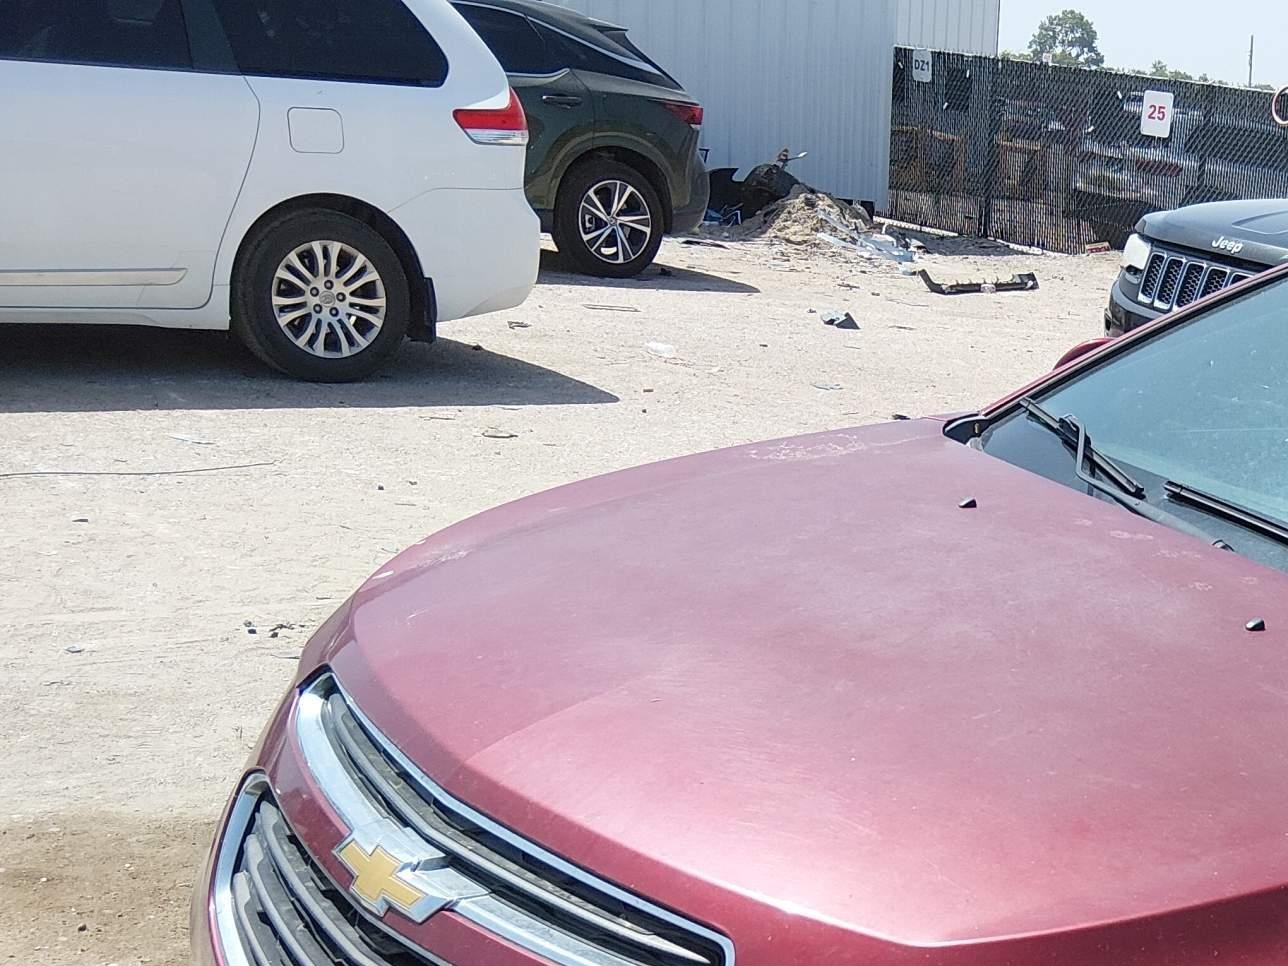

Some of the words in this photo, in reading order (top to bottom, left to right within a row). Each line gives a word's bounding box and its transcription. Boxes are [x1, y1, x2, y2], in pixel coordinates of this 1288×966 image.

[914, 59, 930, 72] DZ1
[1147, 104, 1166, 121] 25
[1211, 236, 1243, 254] Jeep
